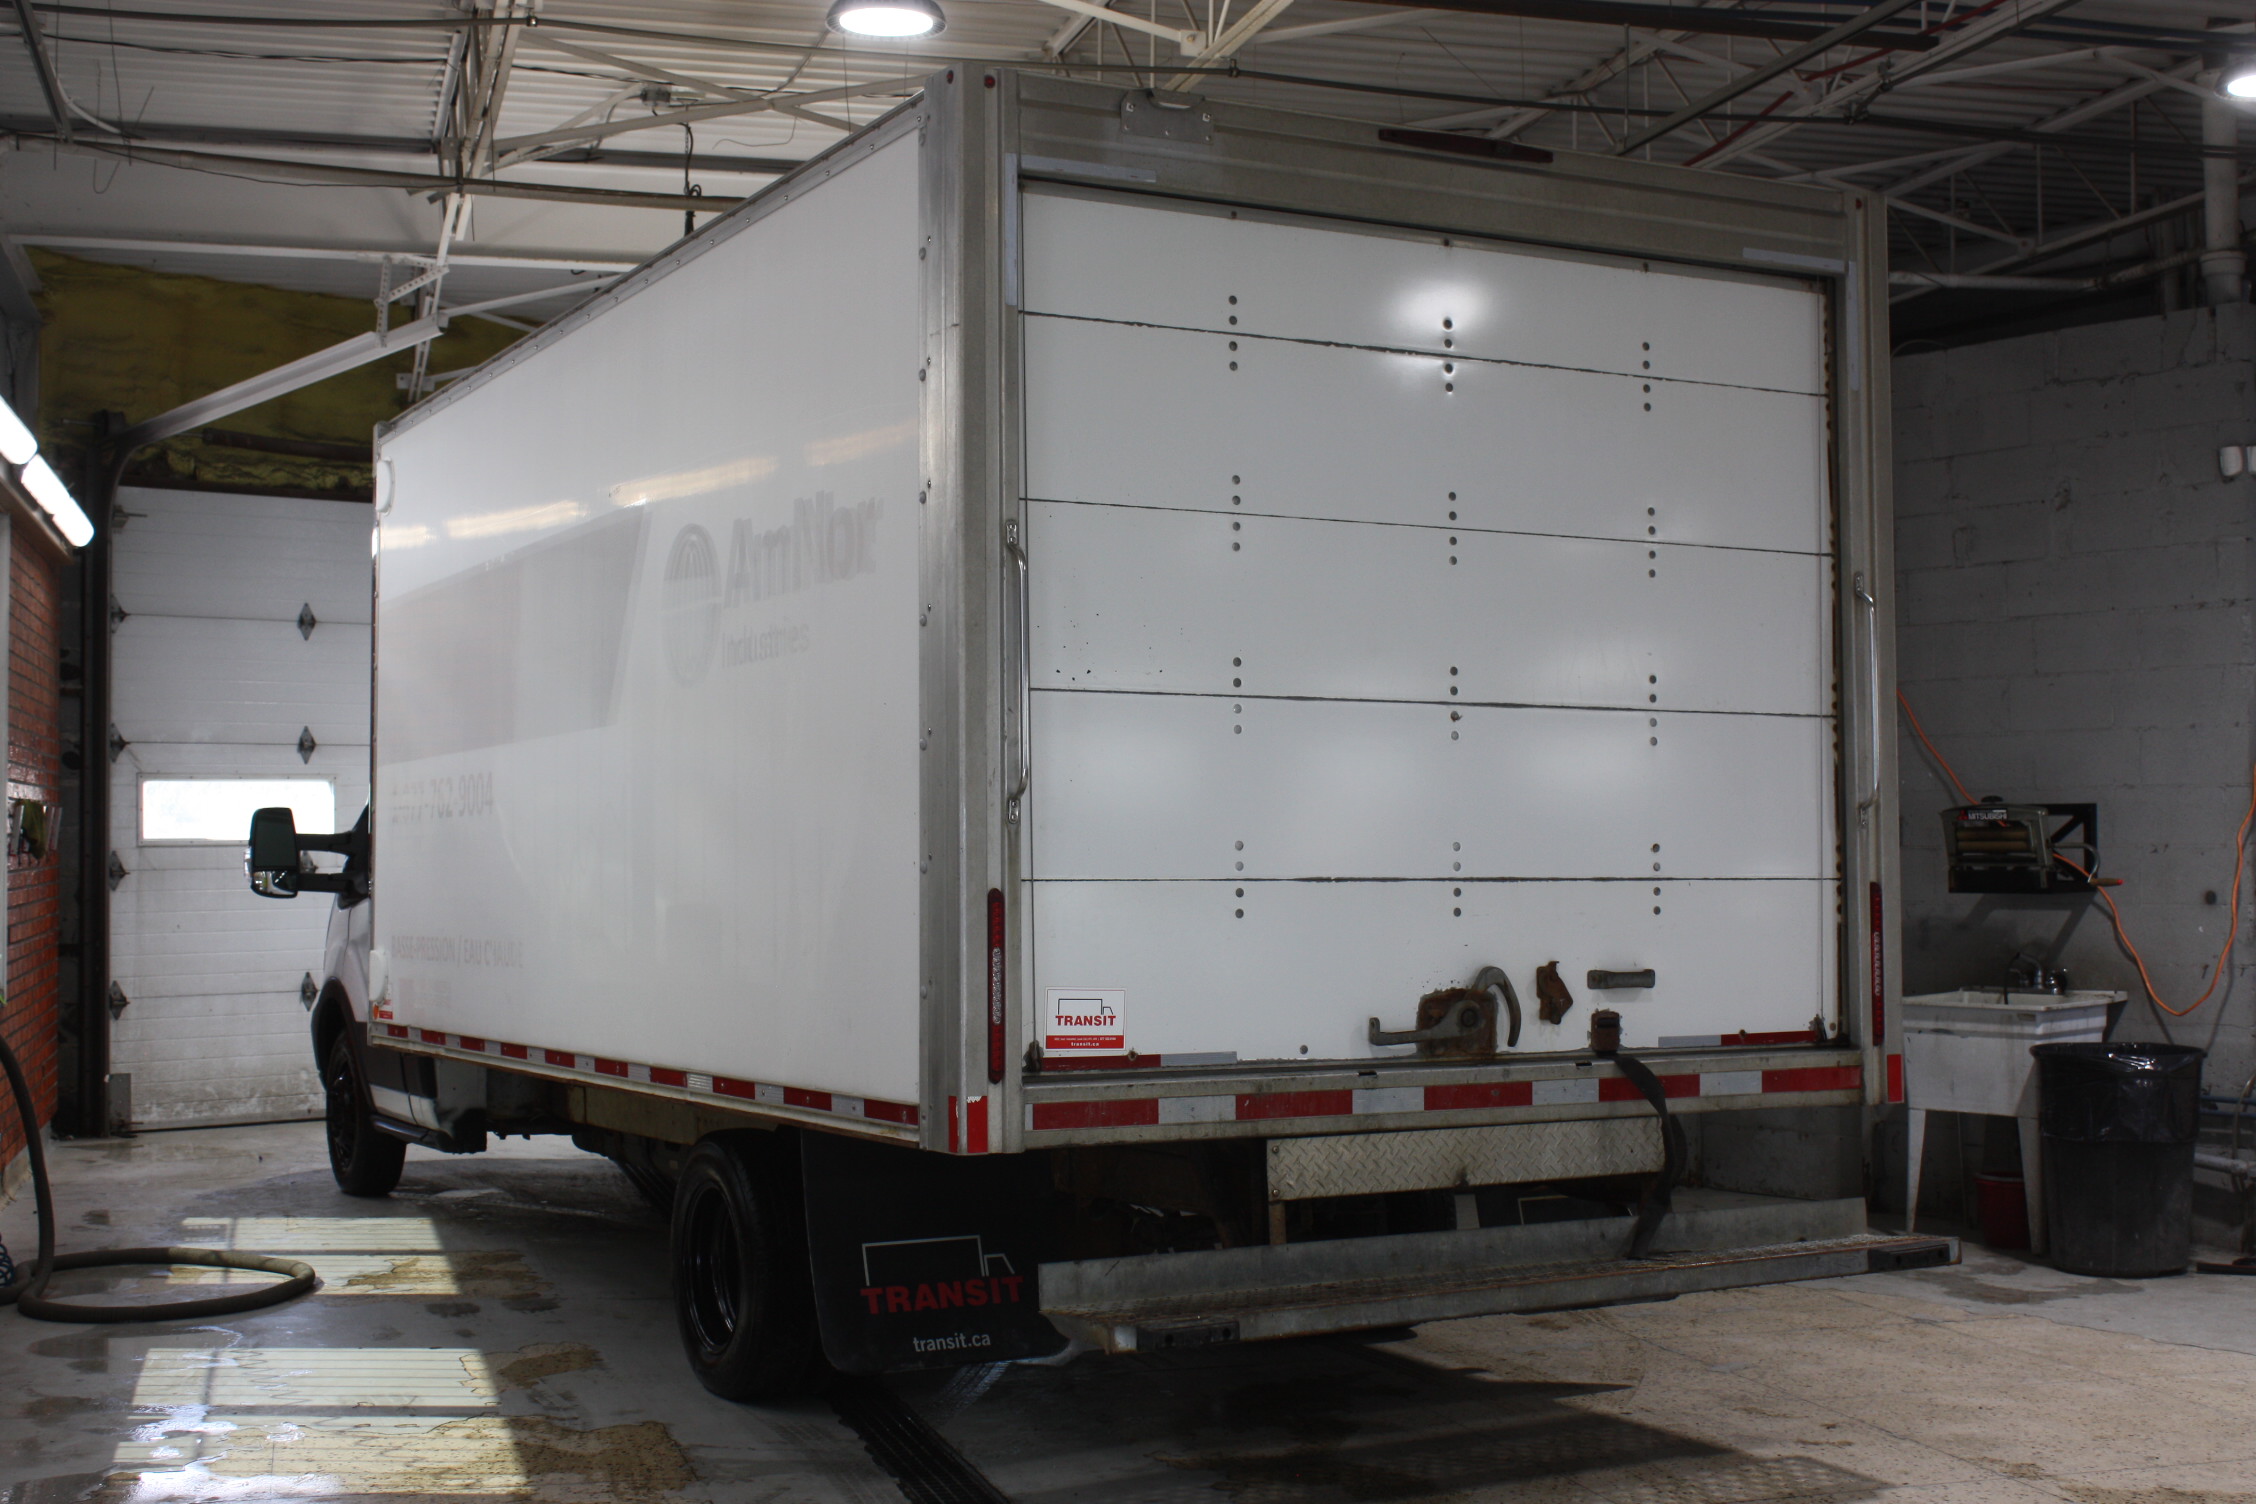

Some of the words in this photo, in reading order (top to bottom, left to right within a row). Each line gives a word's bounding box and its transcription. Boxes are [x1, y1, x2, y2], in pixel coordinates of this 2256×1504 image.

[1968, 812, 2008, 820] MITSUBISHI
[1055, 1015, 1116, 1026] TRANSIT
[860, 1275, 1024, 1315] TRANSIT
[912, 1331, 991, 1353] transit.ca
